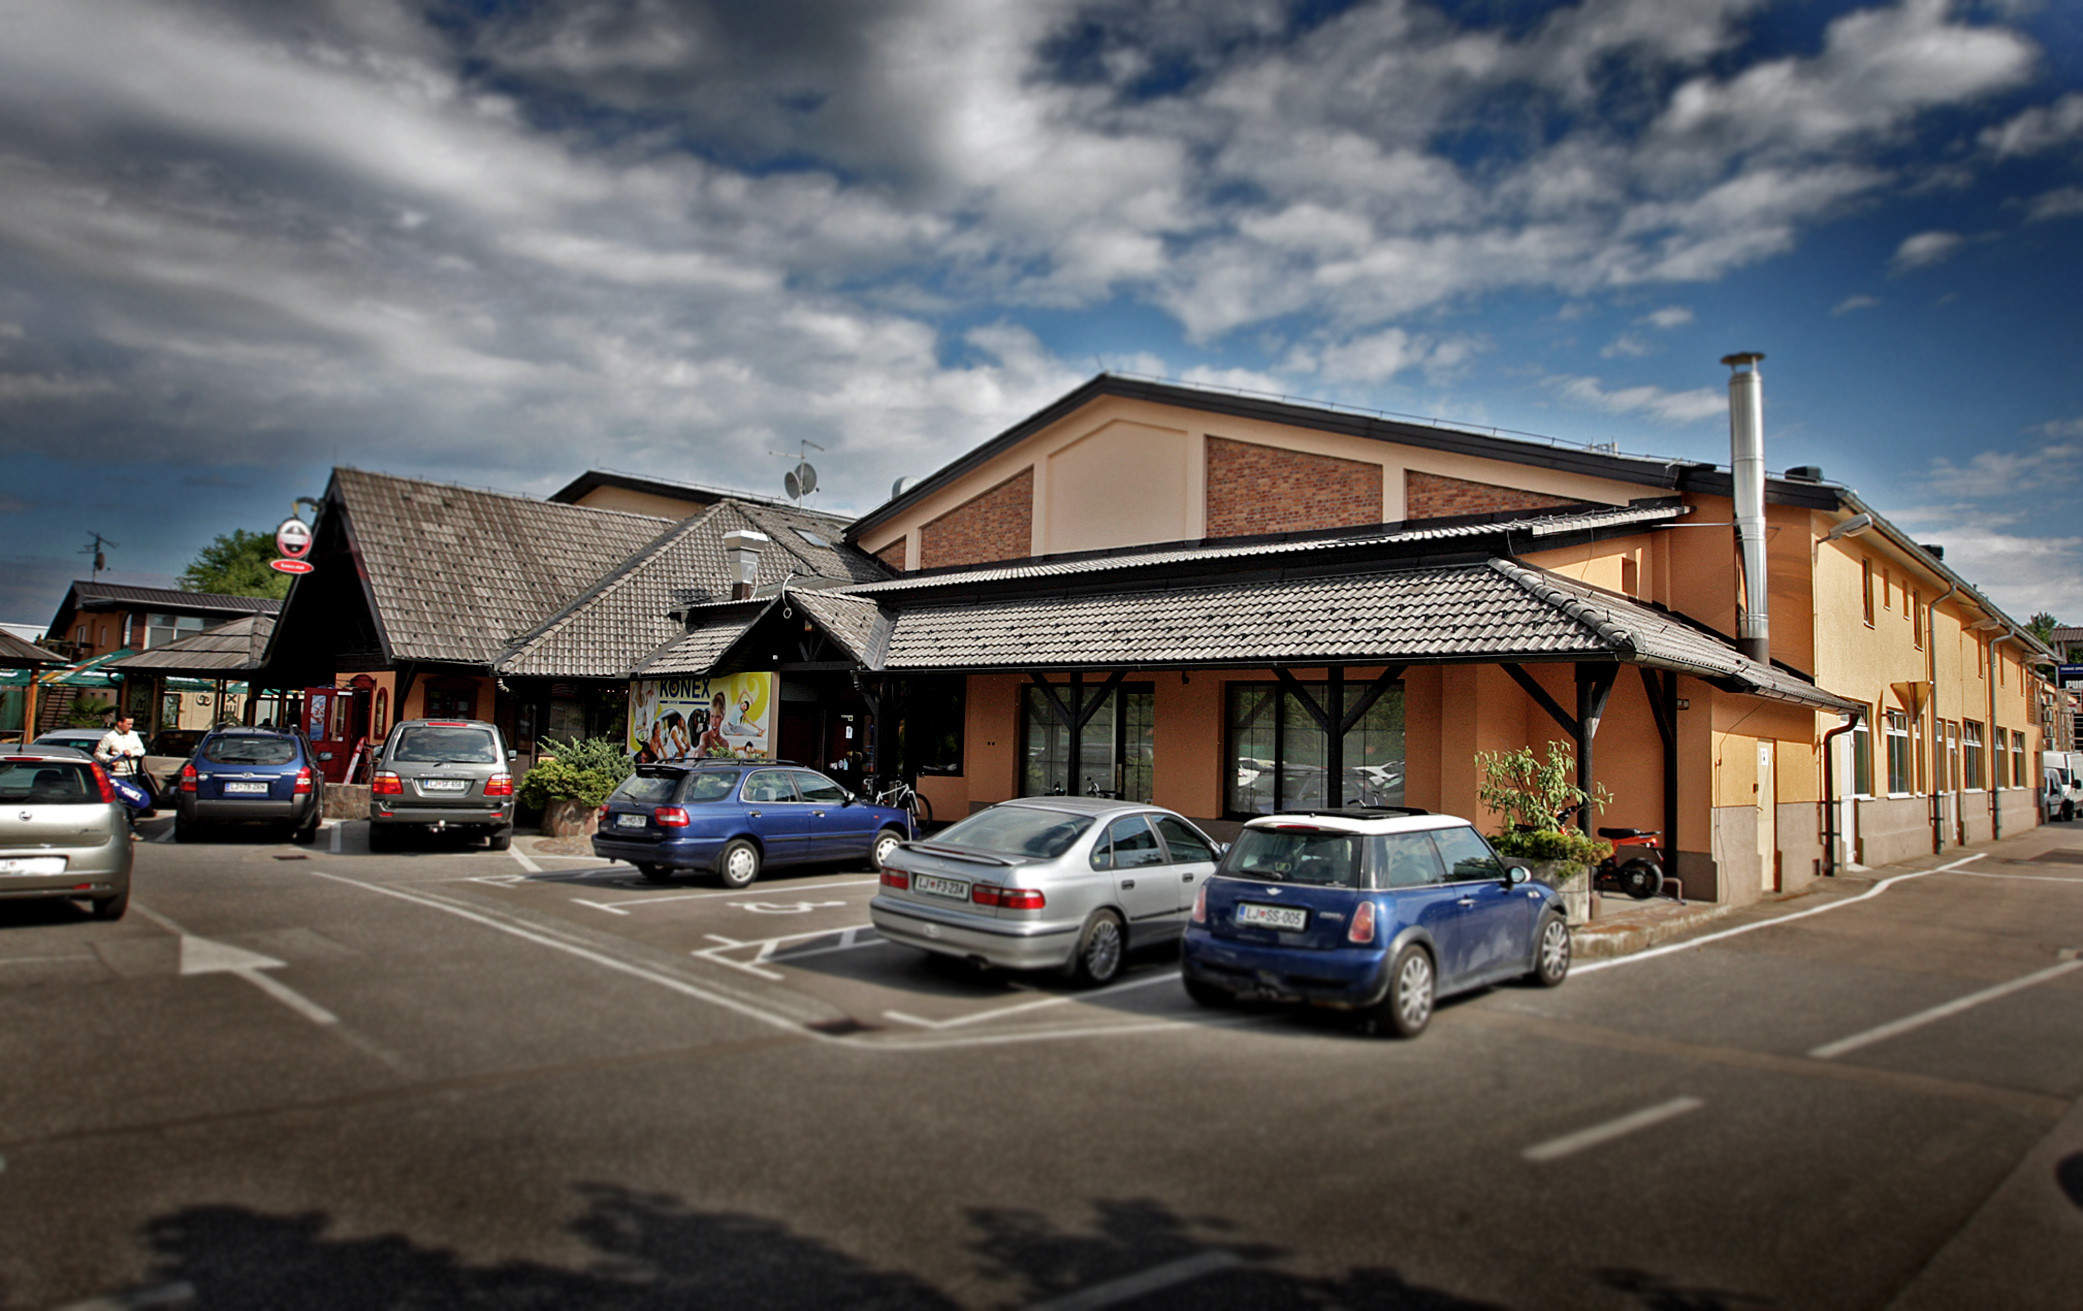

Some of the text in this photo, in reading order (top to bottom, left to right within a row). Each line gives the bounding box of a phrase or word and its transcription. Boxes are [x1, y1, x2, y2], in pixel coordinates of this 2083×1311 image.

[659, 677, 711, 699] KONEX
[918, 876, 930, 889] LJ
[1246, 907, 1260, 920] LJ
[1265, 909, 1302, 925] SS-005
